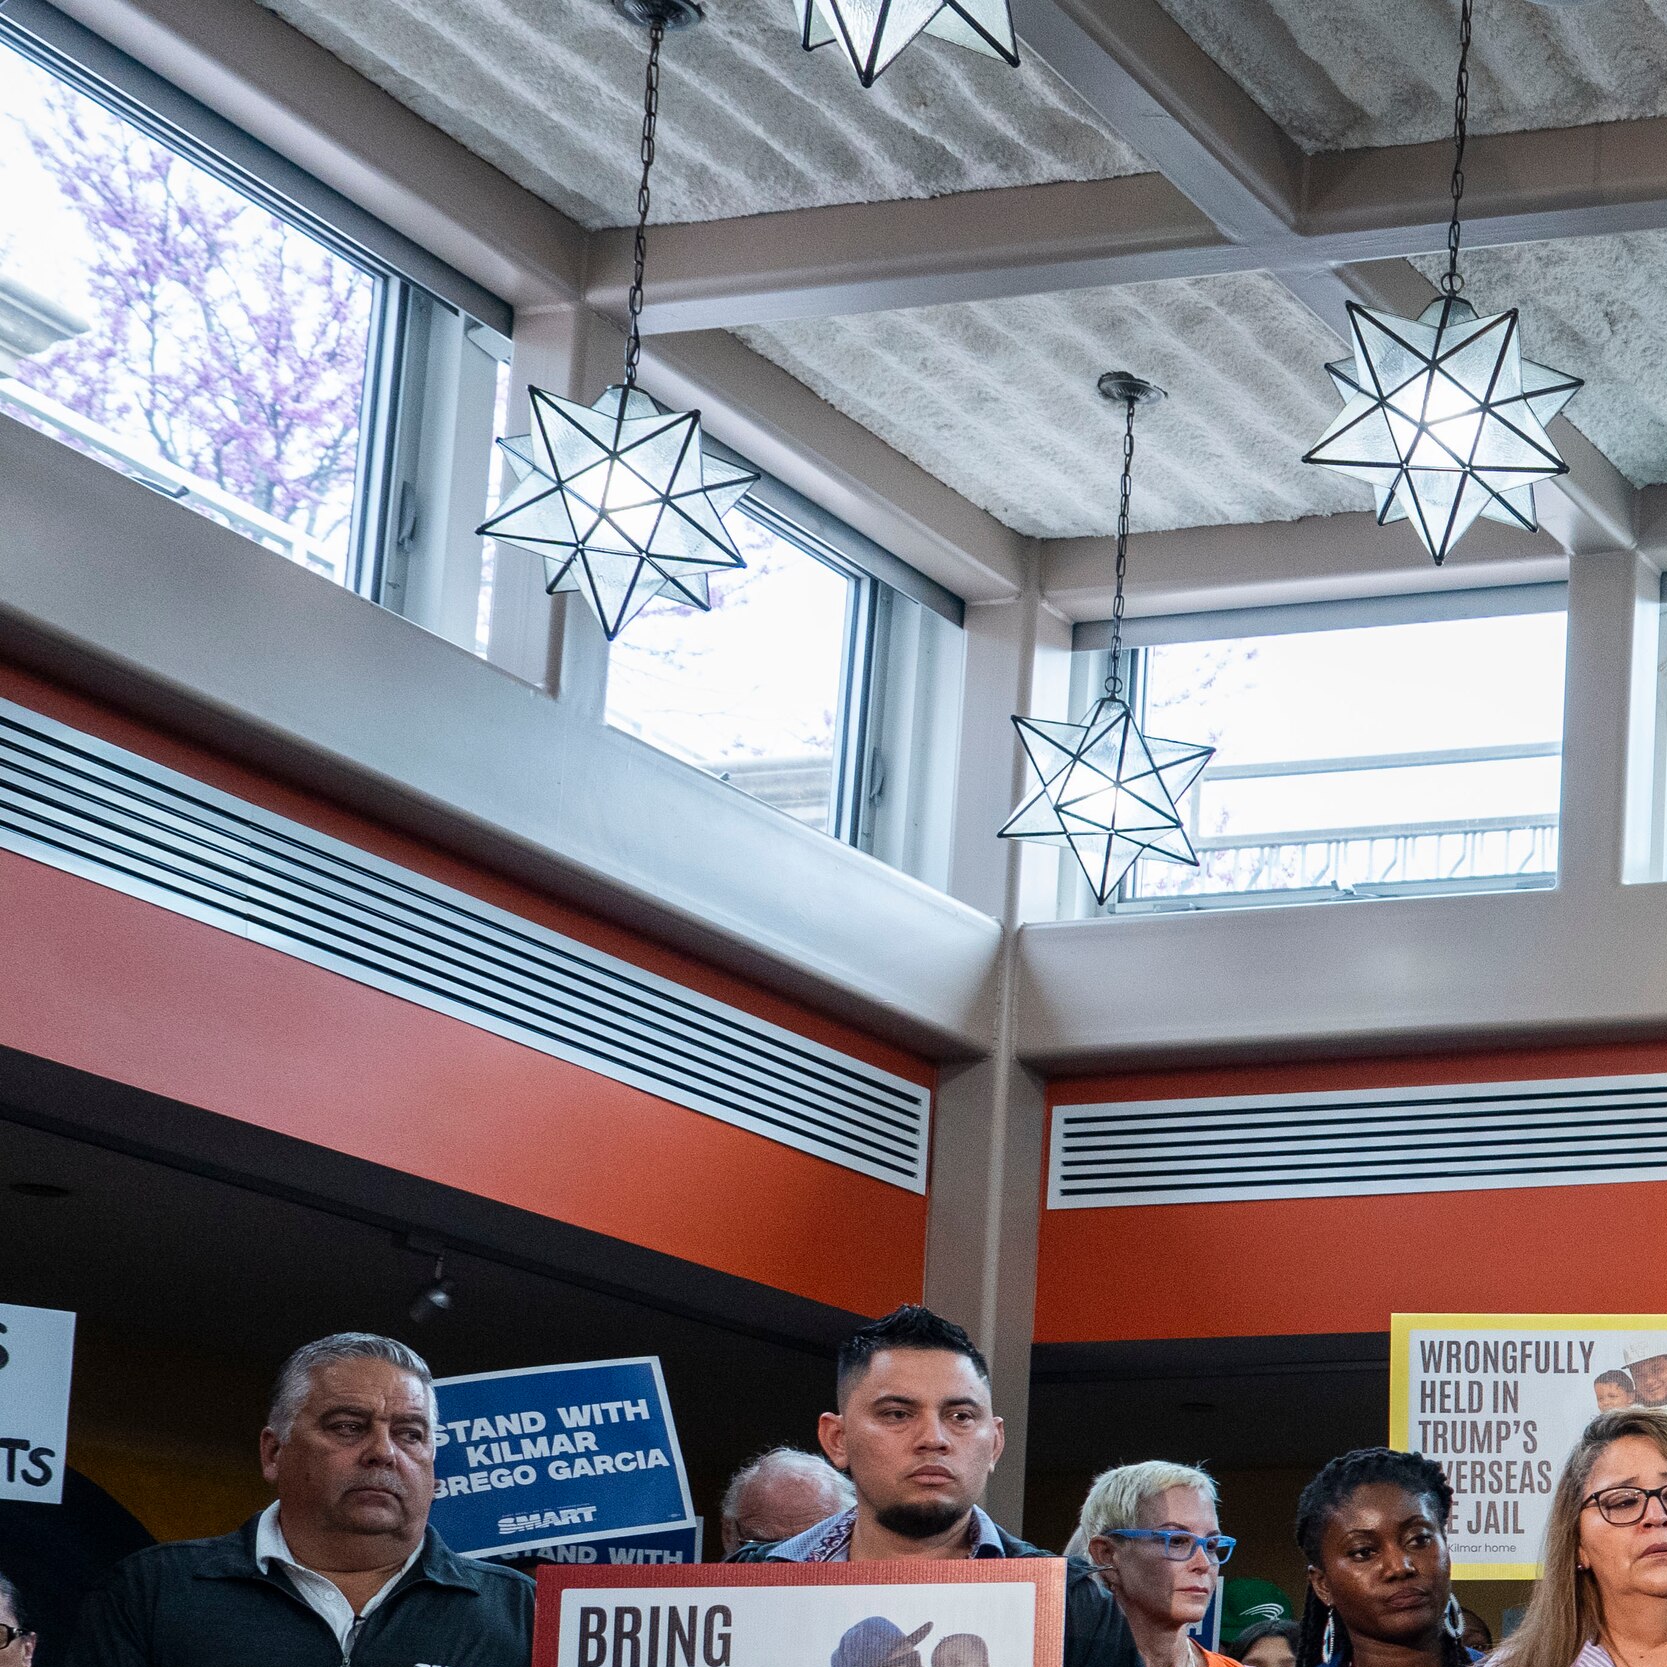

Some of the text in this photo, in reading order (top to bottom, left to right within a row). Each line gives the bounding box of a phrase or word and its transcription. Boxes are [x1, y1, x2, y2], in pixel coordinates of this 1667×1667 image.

[1420, 1340, 1595, 1374] WRONGFULLY
[557, 1399, 650, 1429] WITH
[1420, 1380, 1519, 1414] HELD IN
[466, 1431, 600, 1467] KILMAR
[1418, 1420, 1538, 1454] TRUMP'S
[434, 1448, 670, 1499] BREGO GARCIA
[1440, 1460, 1552, 1494] VERSEAS
[497, 1506, 598, 1535] SMART
[1467, 1500, 1525, 1534] JAIL
[1449, 1543, 1517, 1553] Kilmar home
